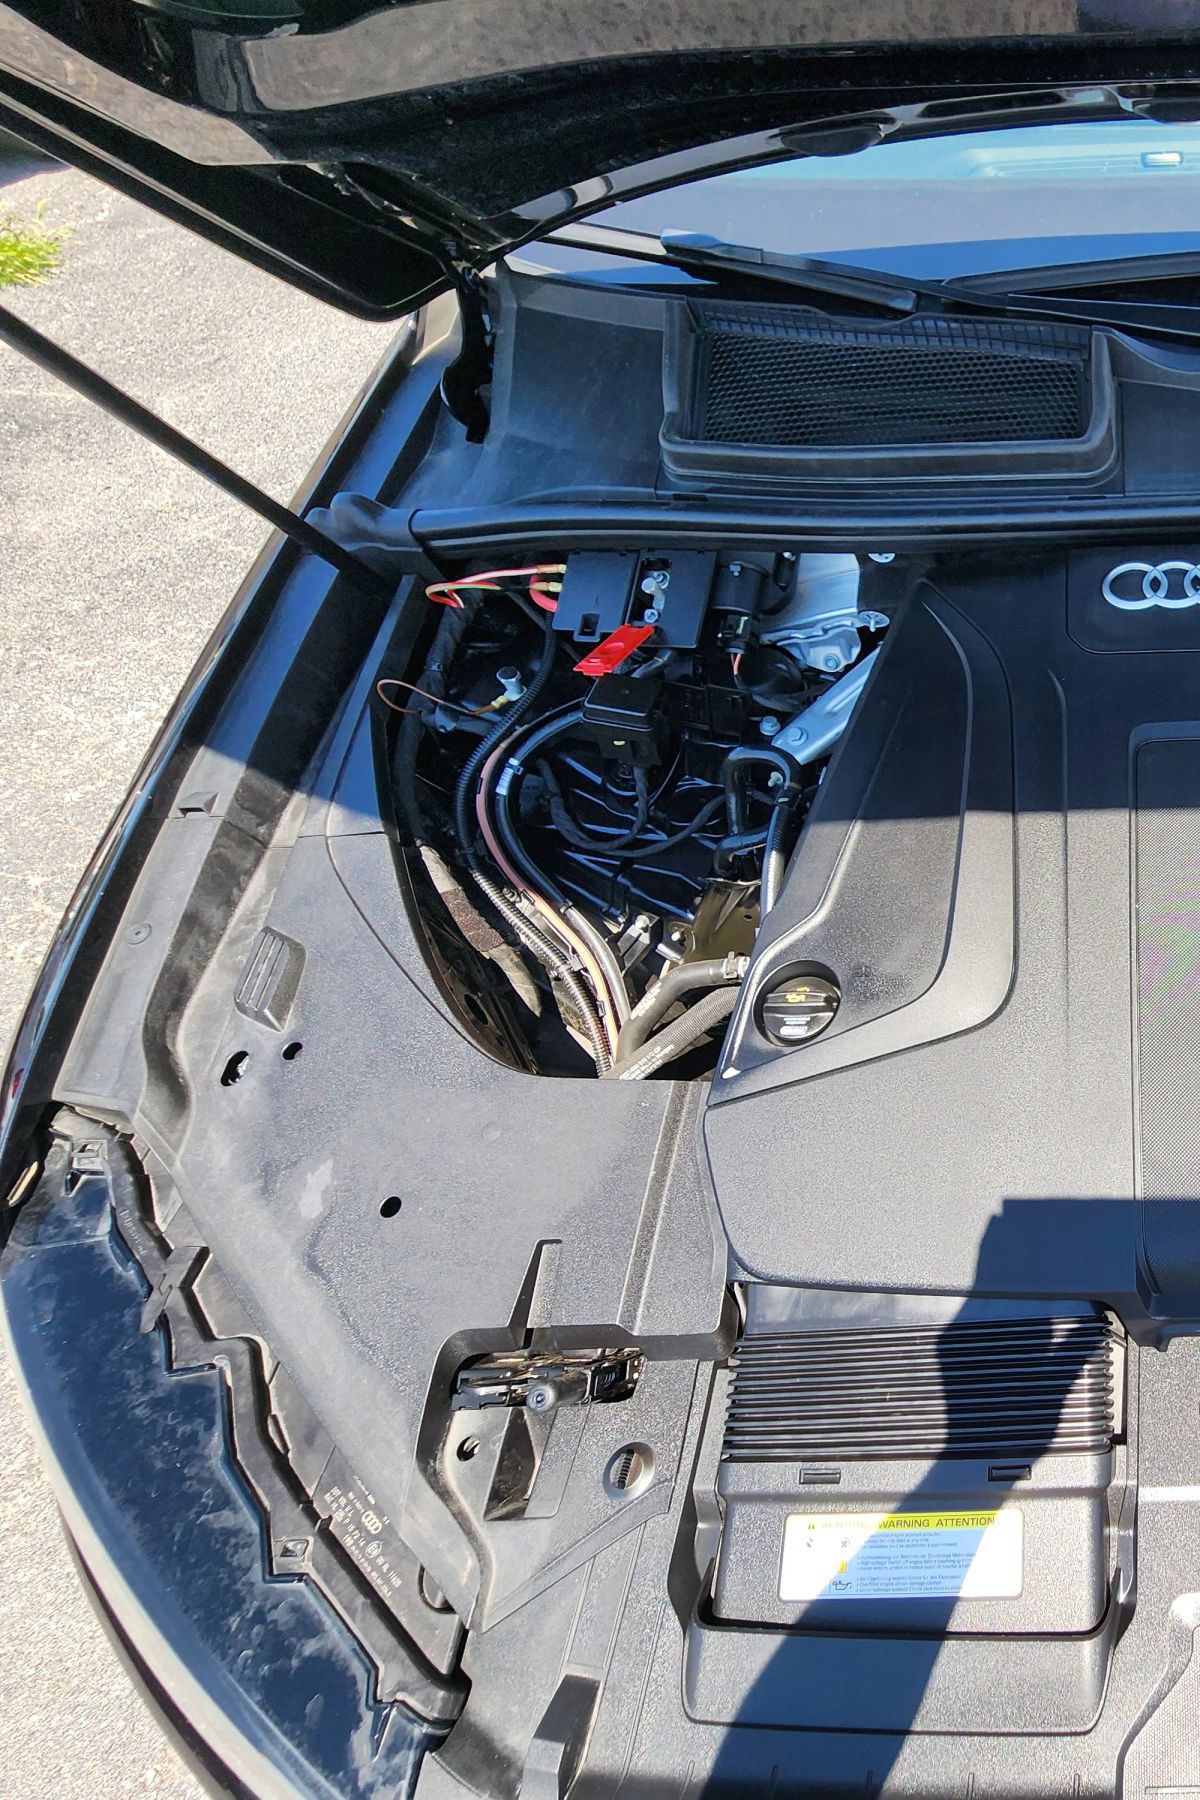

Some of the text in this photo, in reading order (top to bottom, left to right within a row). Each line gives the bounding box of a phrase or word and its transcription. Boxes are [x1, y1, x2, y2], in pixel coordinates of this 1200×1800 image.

[821, 1516, 995, 1530] ACHTUN WARNING ATTENTION
